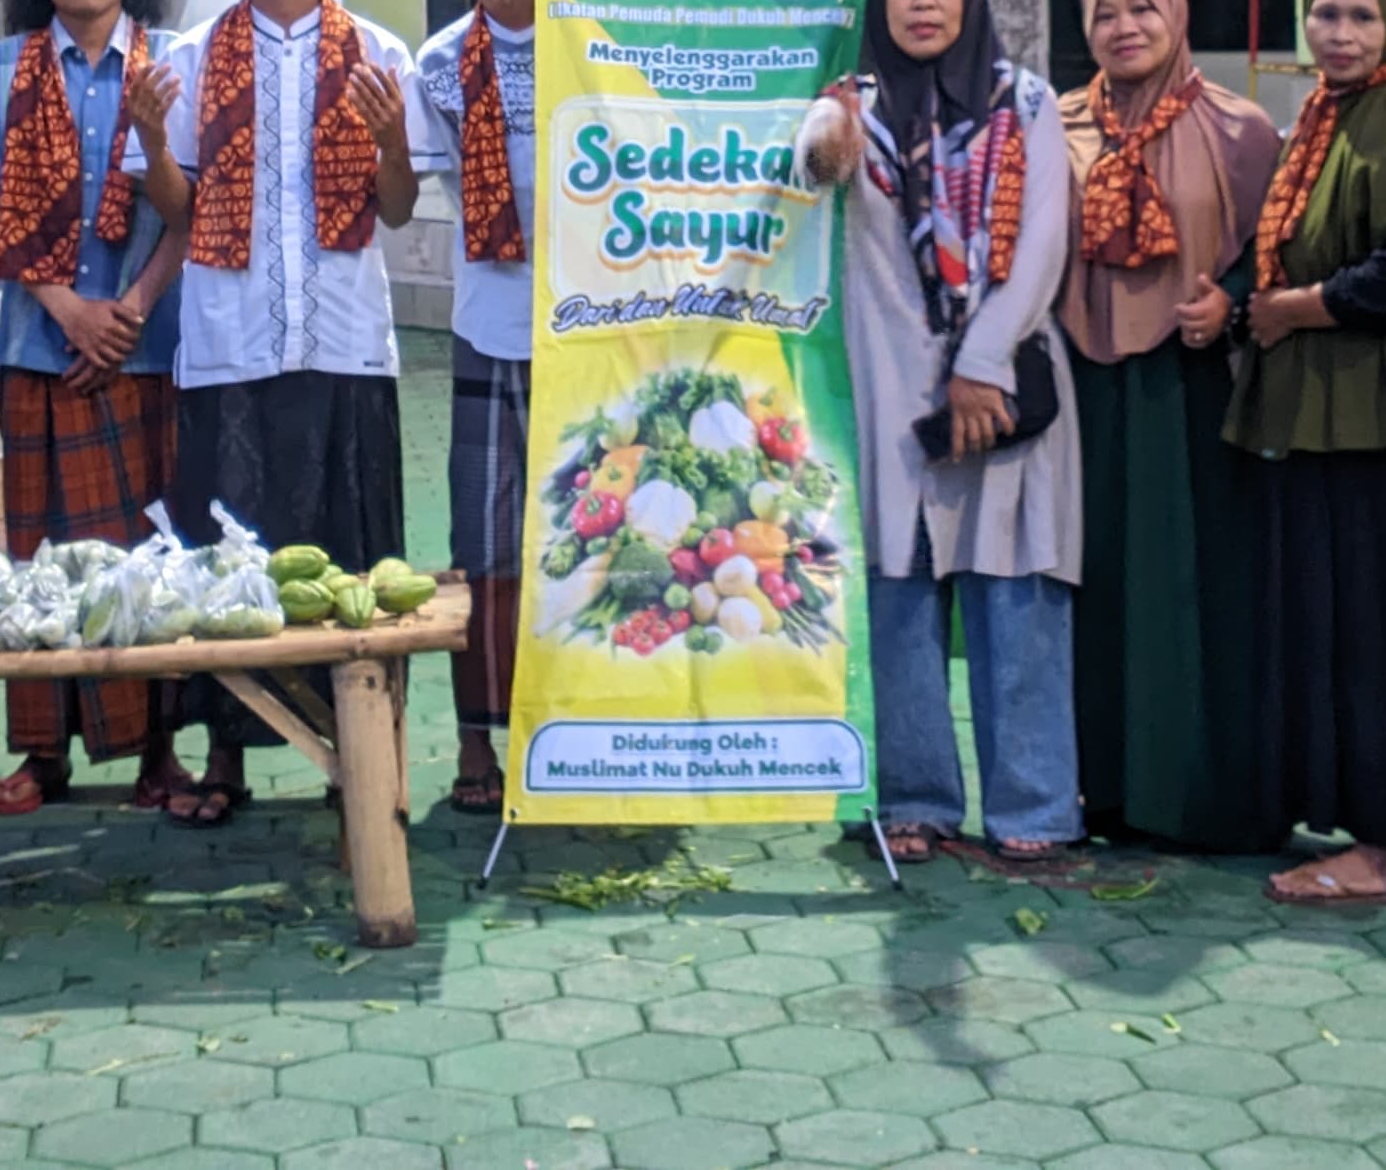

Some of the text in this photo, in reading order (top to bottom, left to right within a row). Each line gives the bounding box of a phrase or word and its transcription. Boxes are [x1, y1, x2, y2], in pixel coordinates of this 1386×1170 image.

[589, 42, 816, 70] Menyelenggarakan
[650, 69, 754, 90] Program
[567, 124, 815, 194] Sedeka
[603, 190, 785, 265] Sayur
[612, 733, 712, 755] Didukung
[717, 731, 767, 751] Oleh
[547, 757, 842, 778] Muslimat Nu Dukuh Mencek
